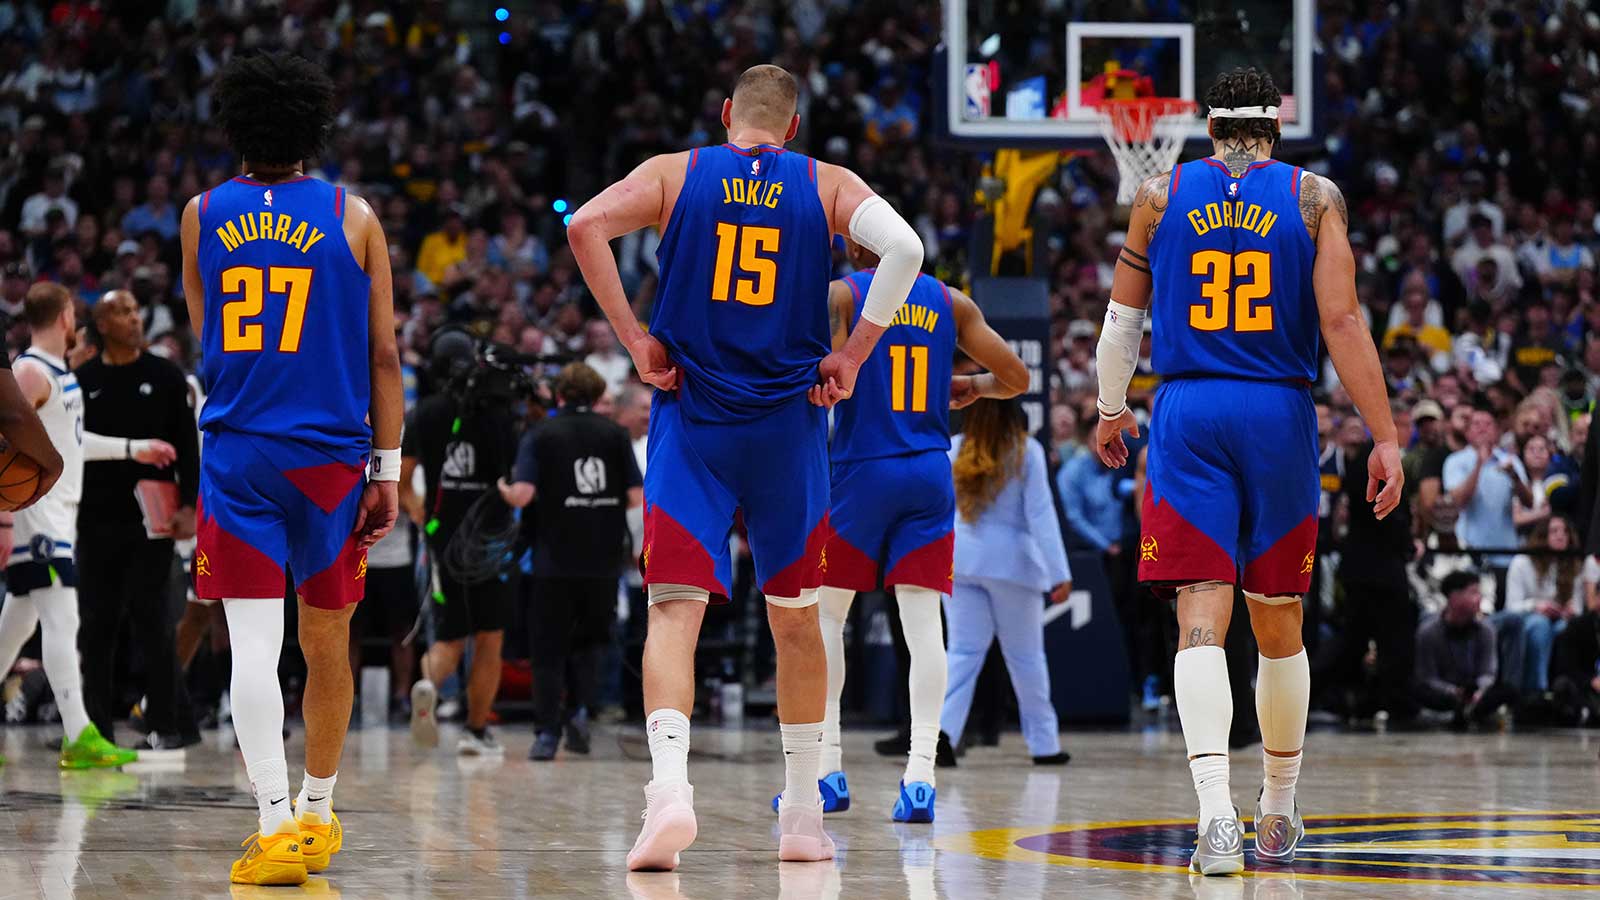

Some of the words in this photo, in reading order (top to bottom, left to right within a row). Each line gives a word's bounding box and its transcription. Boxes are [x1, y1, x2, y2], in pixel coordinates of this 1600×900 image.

[721, 178, 783, 209] JOKIĆ
[1187, 200, 1278, 238] GORDON
[215, 211, 326, 254] MURRAY
[710, 220, 781, 307] 15
[220, 264, 315, 354] 27
[1188, 248, 1275, 333] 32
[889, 344, 929, 412] 11
